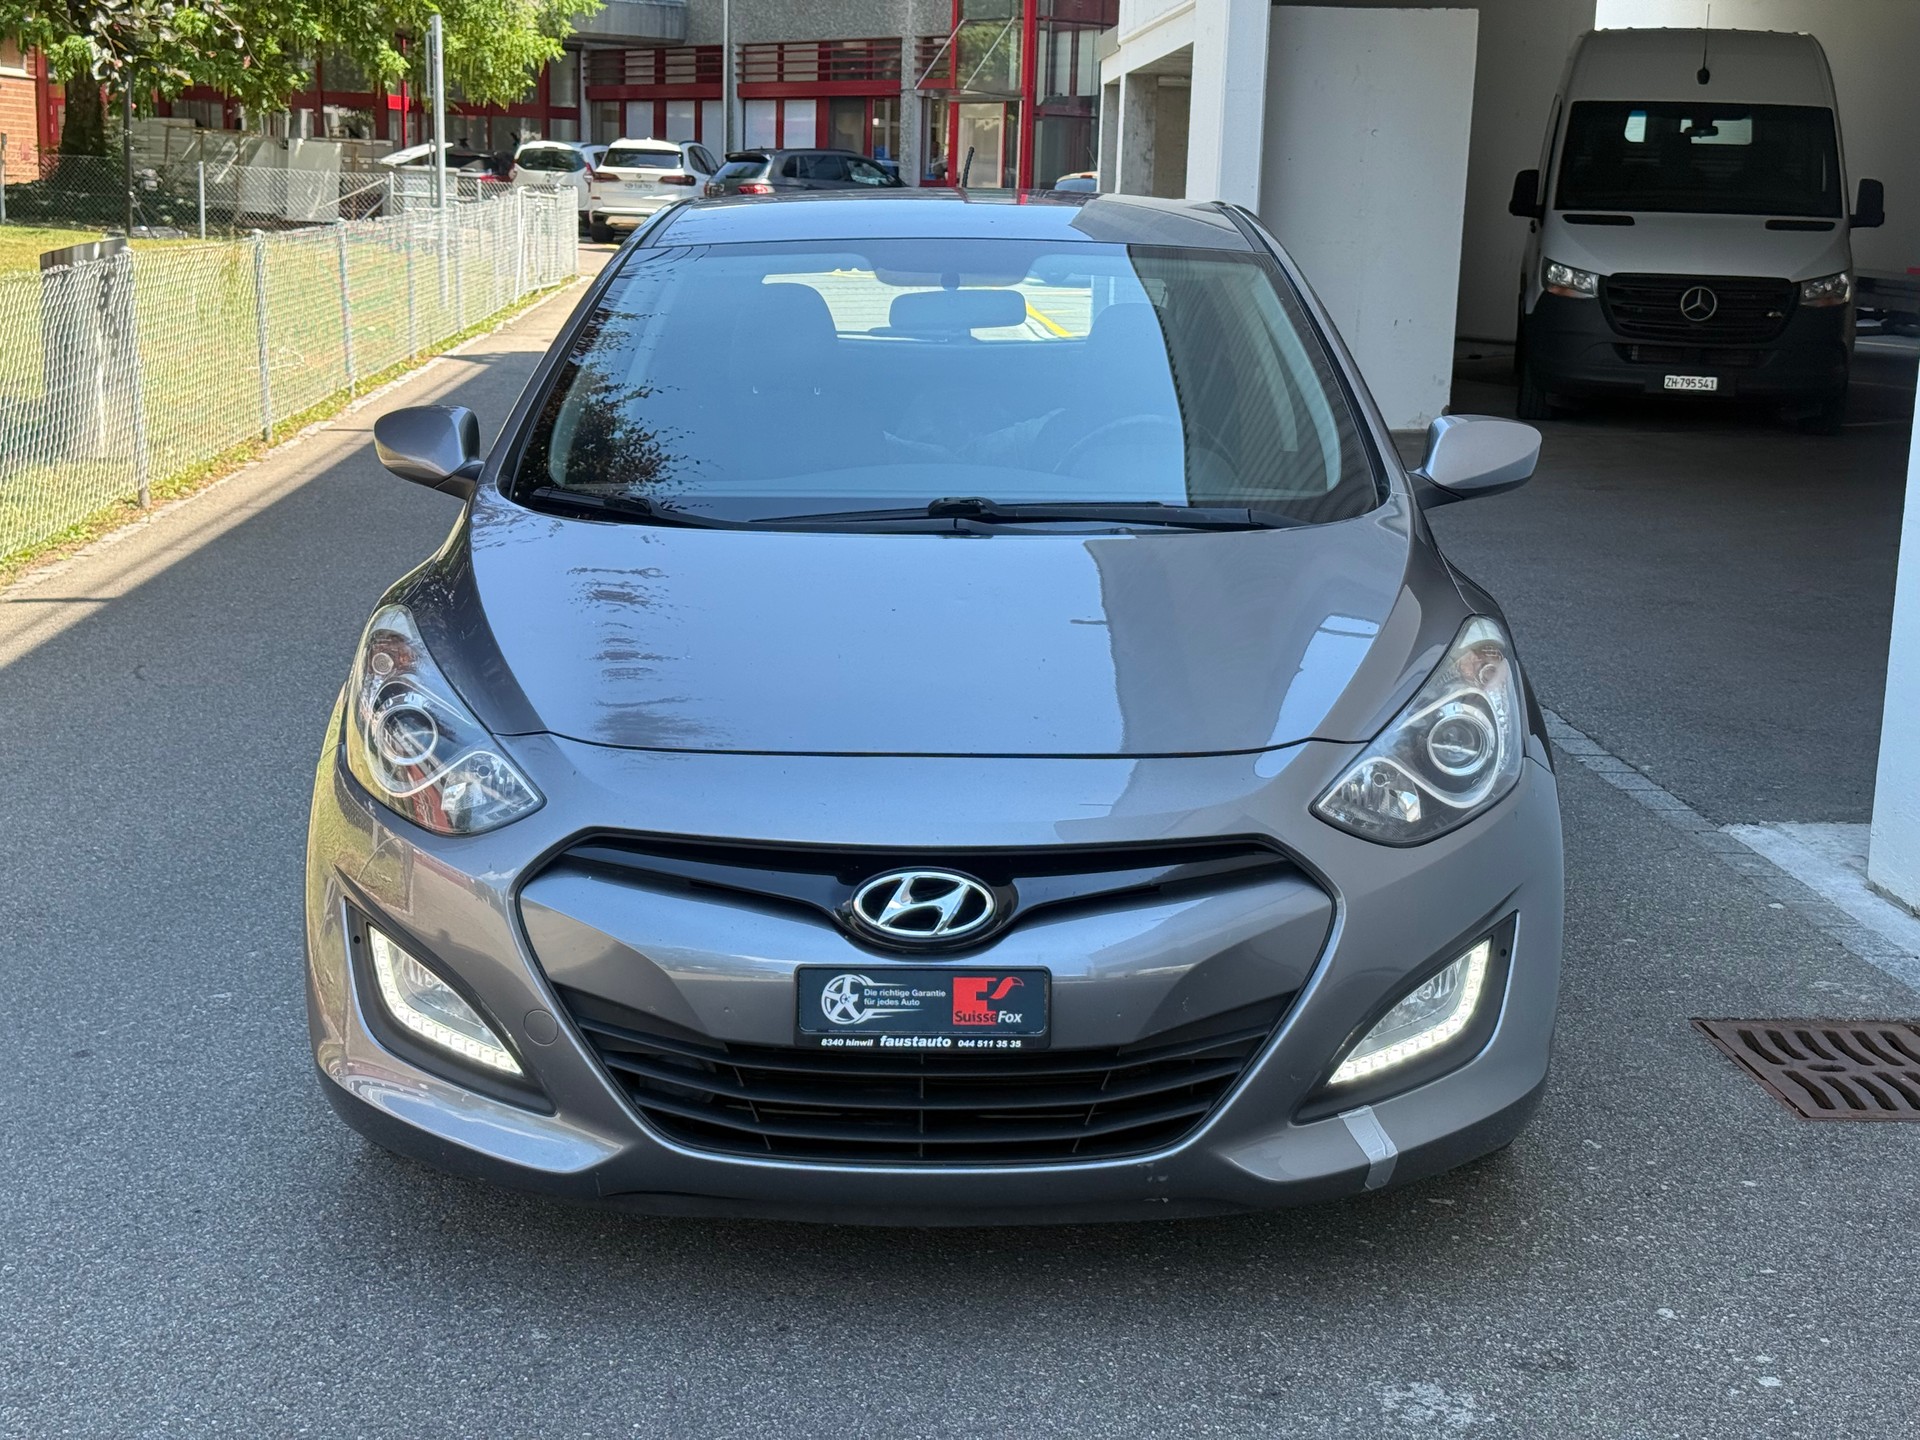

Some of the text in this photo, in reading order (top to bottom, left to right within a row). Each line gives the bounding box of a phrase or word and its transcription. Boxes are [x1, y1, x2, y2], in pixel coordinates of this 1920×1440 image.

[864, 988, 946, 998] Die richtige Garantie
[877, 999, 899, 1007] jedes
[820, 1038, 844, 1047] 8340
[880, 1035, 952, 1048] faustauto
[957, 1040, 975, 1048] 044
[976, 1040, 994, 1048] 511
[995, 1040, 1008, 1048] 35
[1009, 1040, 1021, 1048] 35
